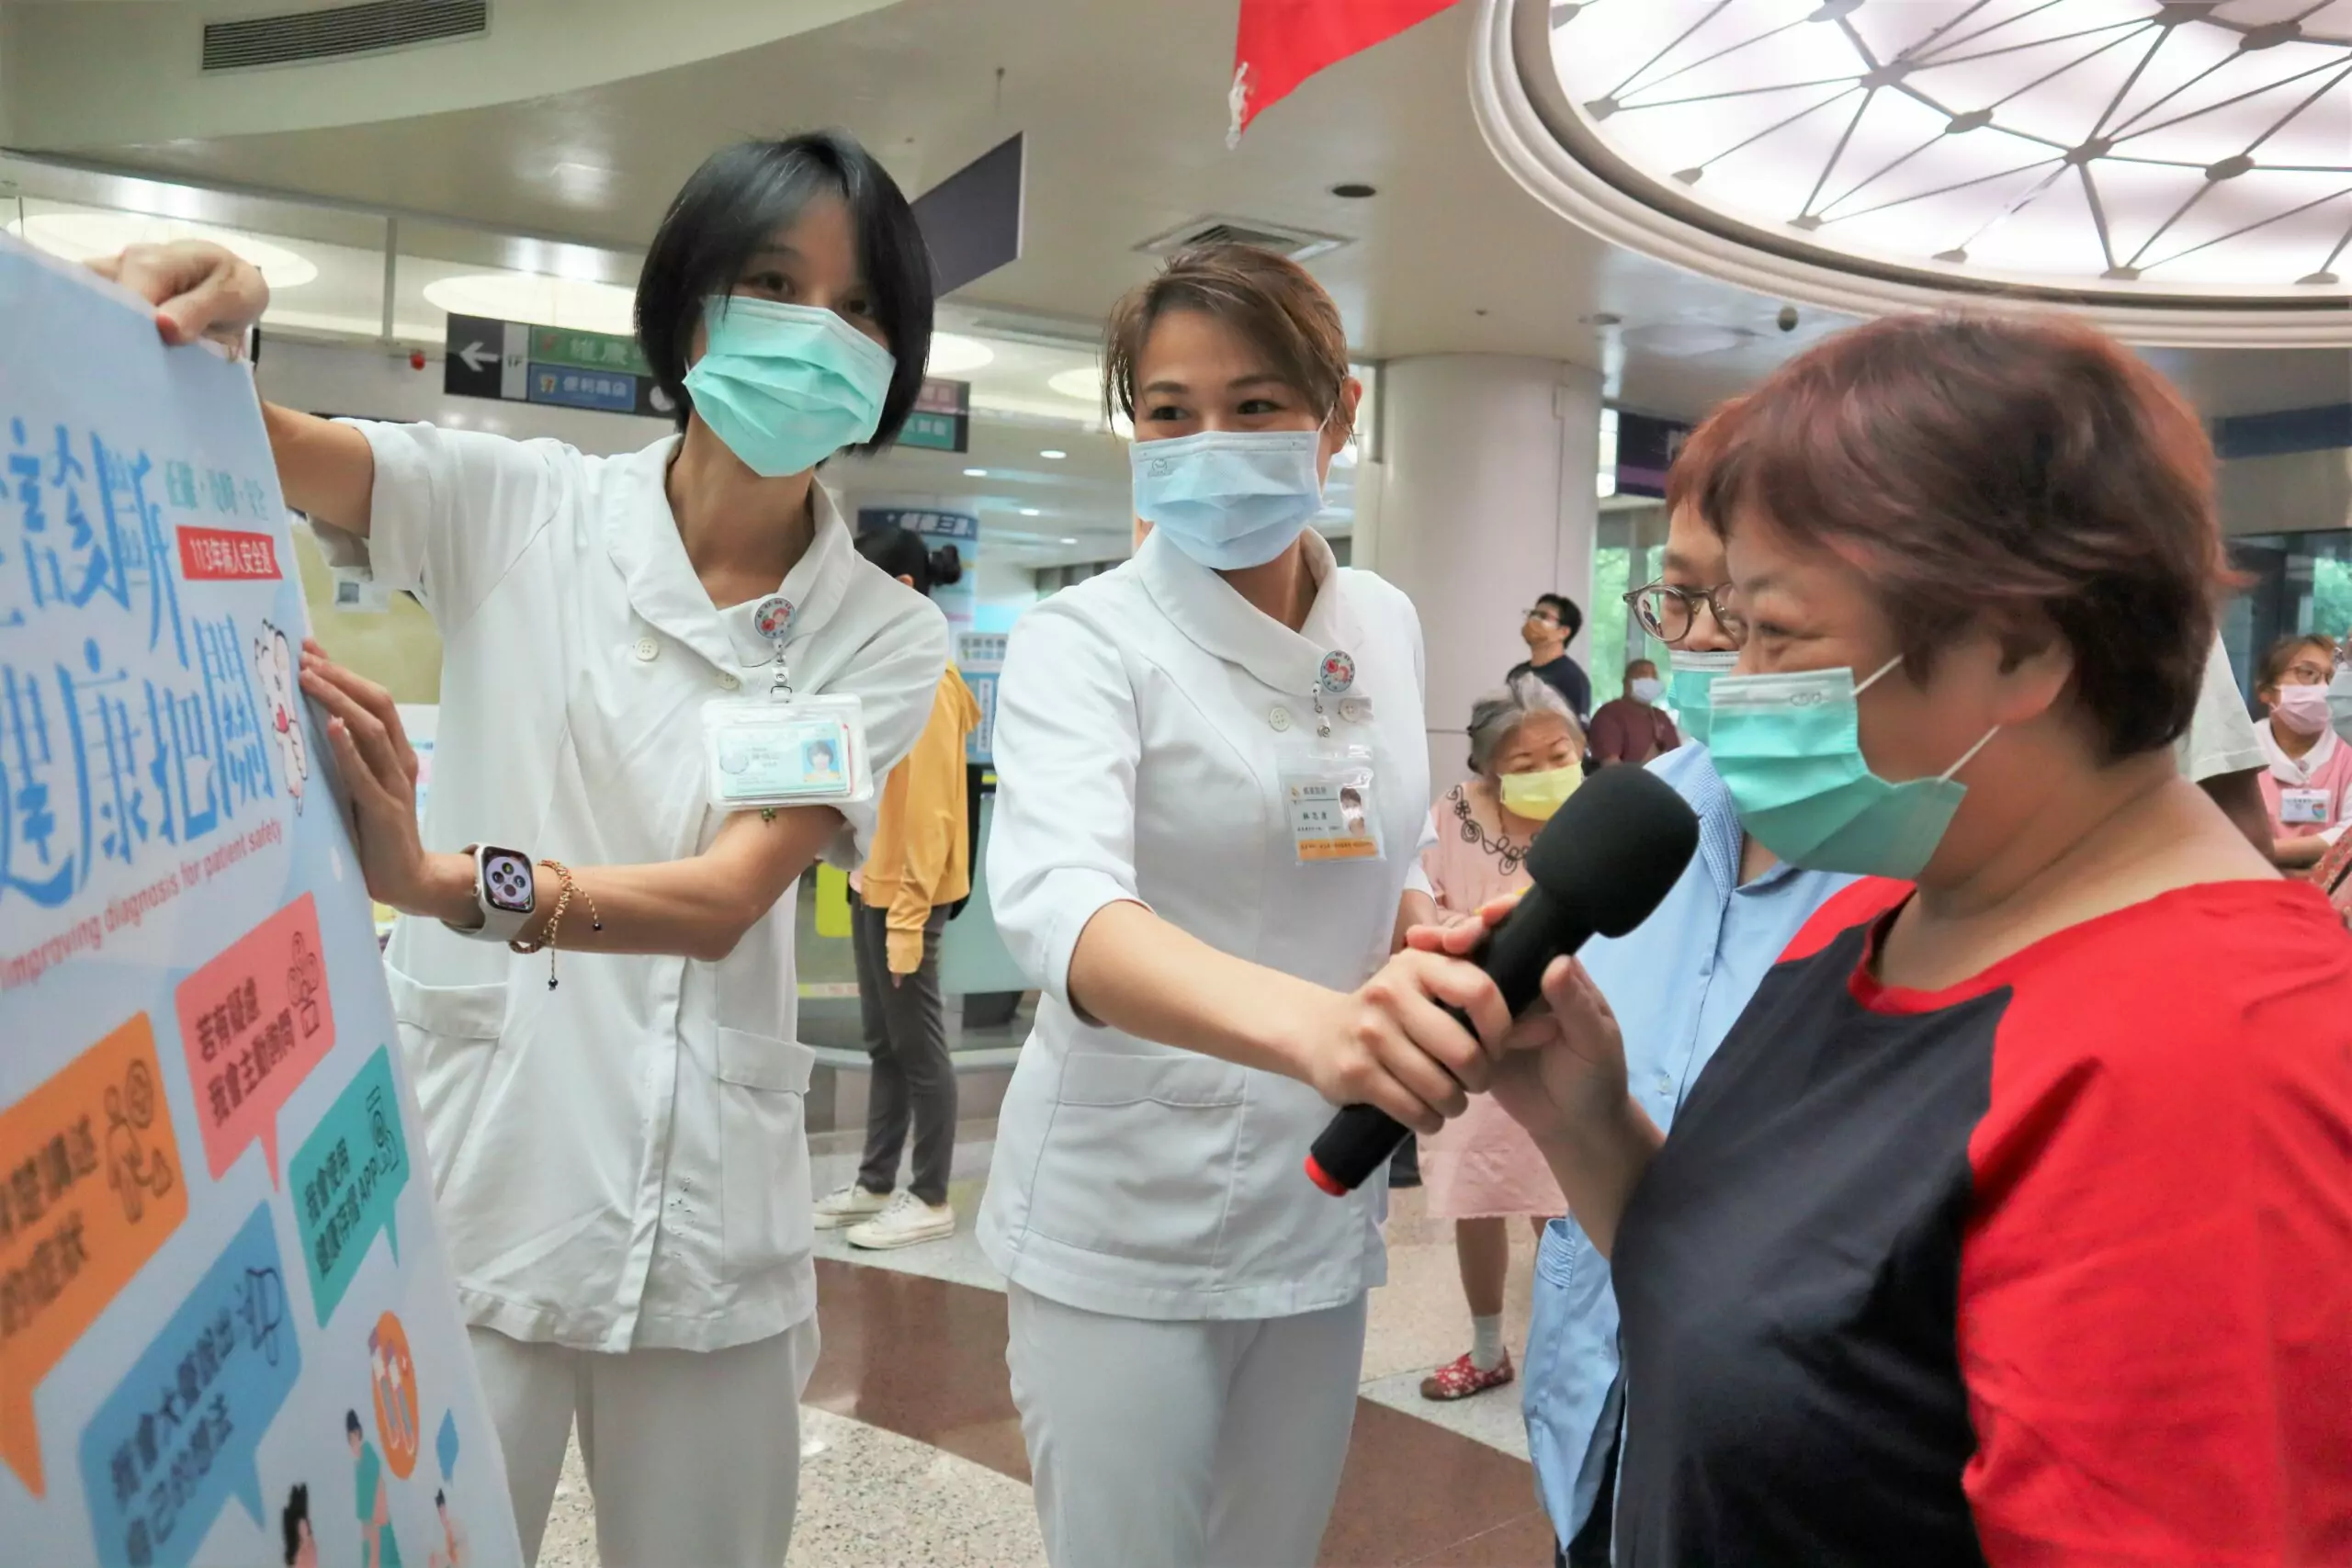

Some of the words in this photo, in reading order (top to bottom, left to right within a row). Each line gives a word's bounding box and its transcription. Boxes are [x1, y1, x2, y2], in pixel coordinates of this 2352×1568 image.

[562, 375, 628, 398] 便利商店
[0, 415, 189, 673] 診斷
[104, 873, 180, 927] diagnosis
[180, 861, 200, 887] for
[203, 833, 248, 883] patient
[249, 817, 283, 852] safety
[357, 1156, 378, 1206] APP
